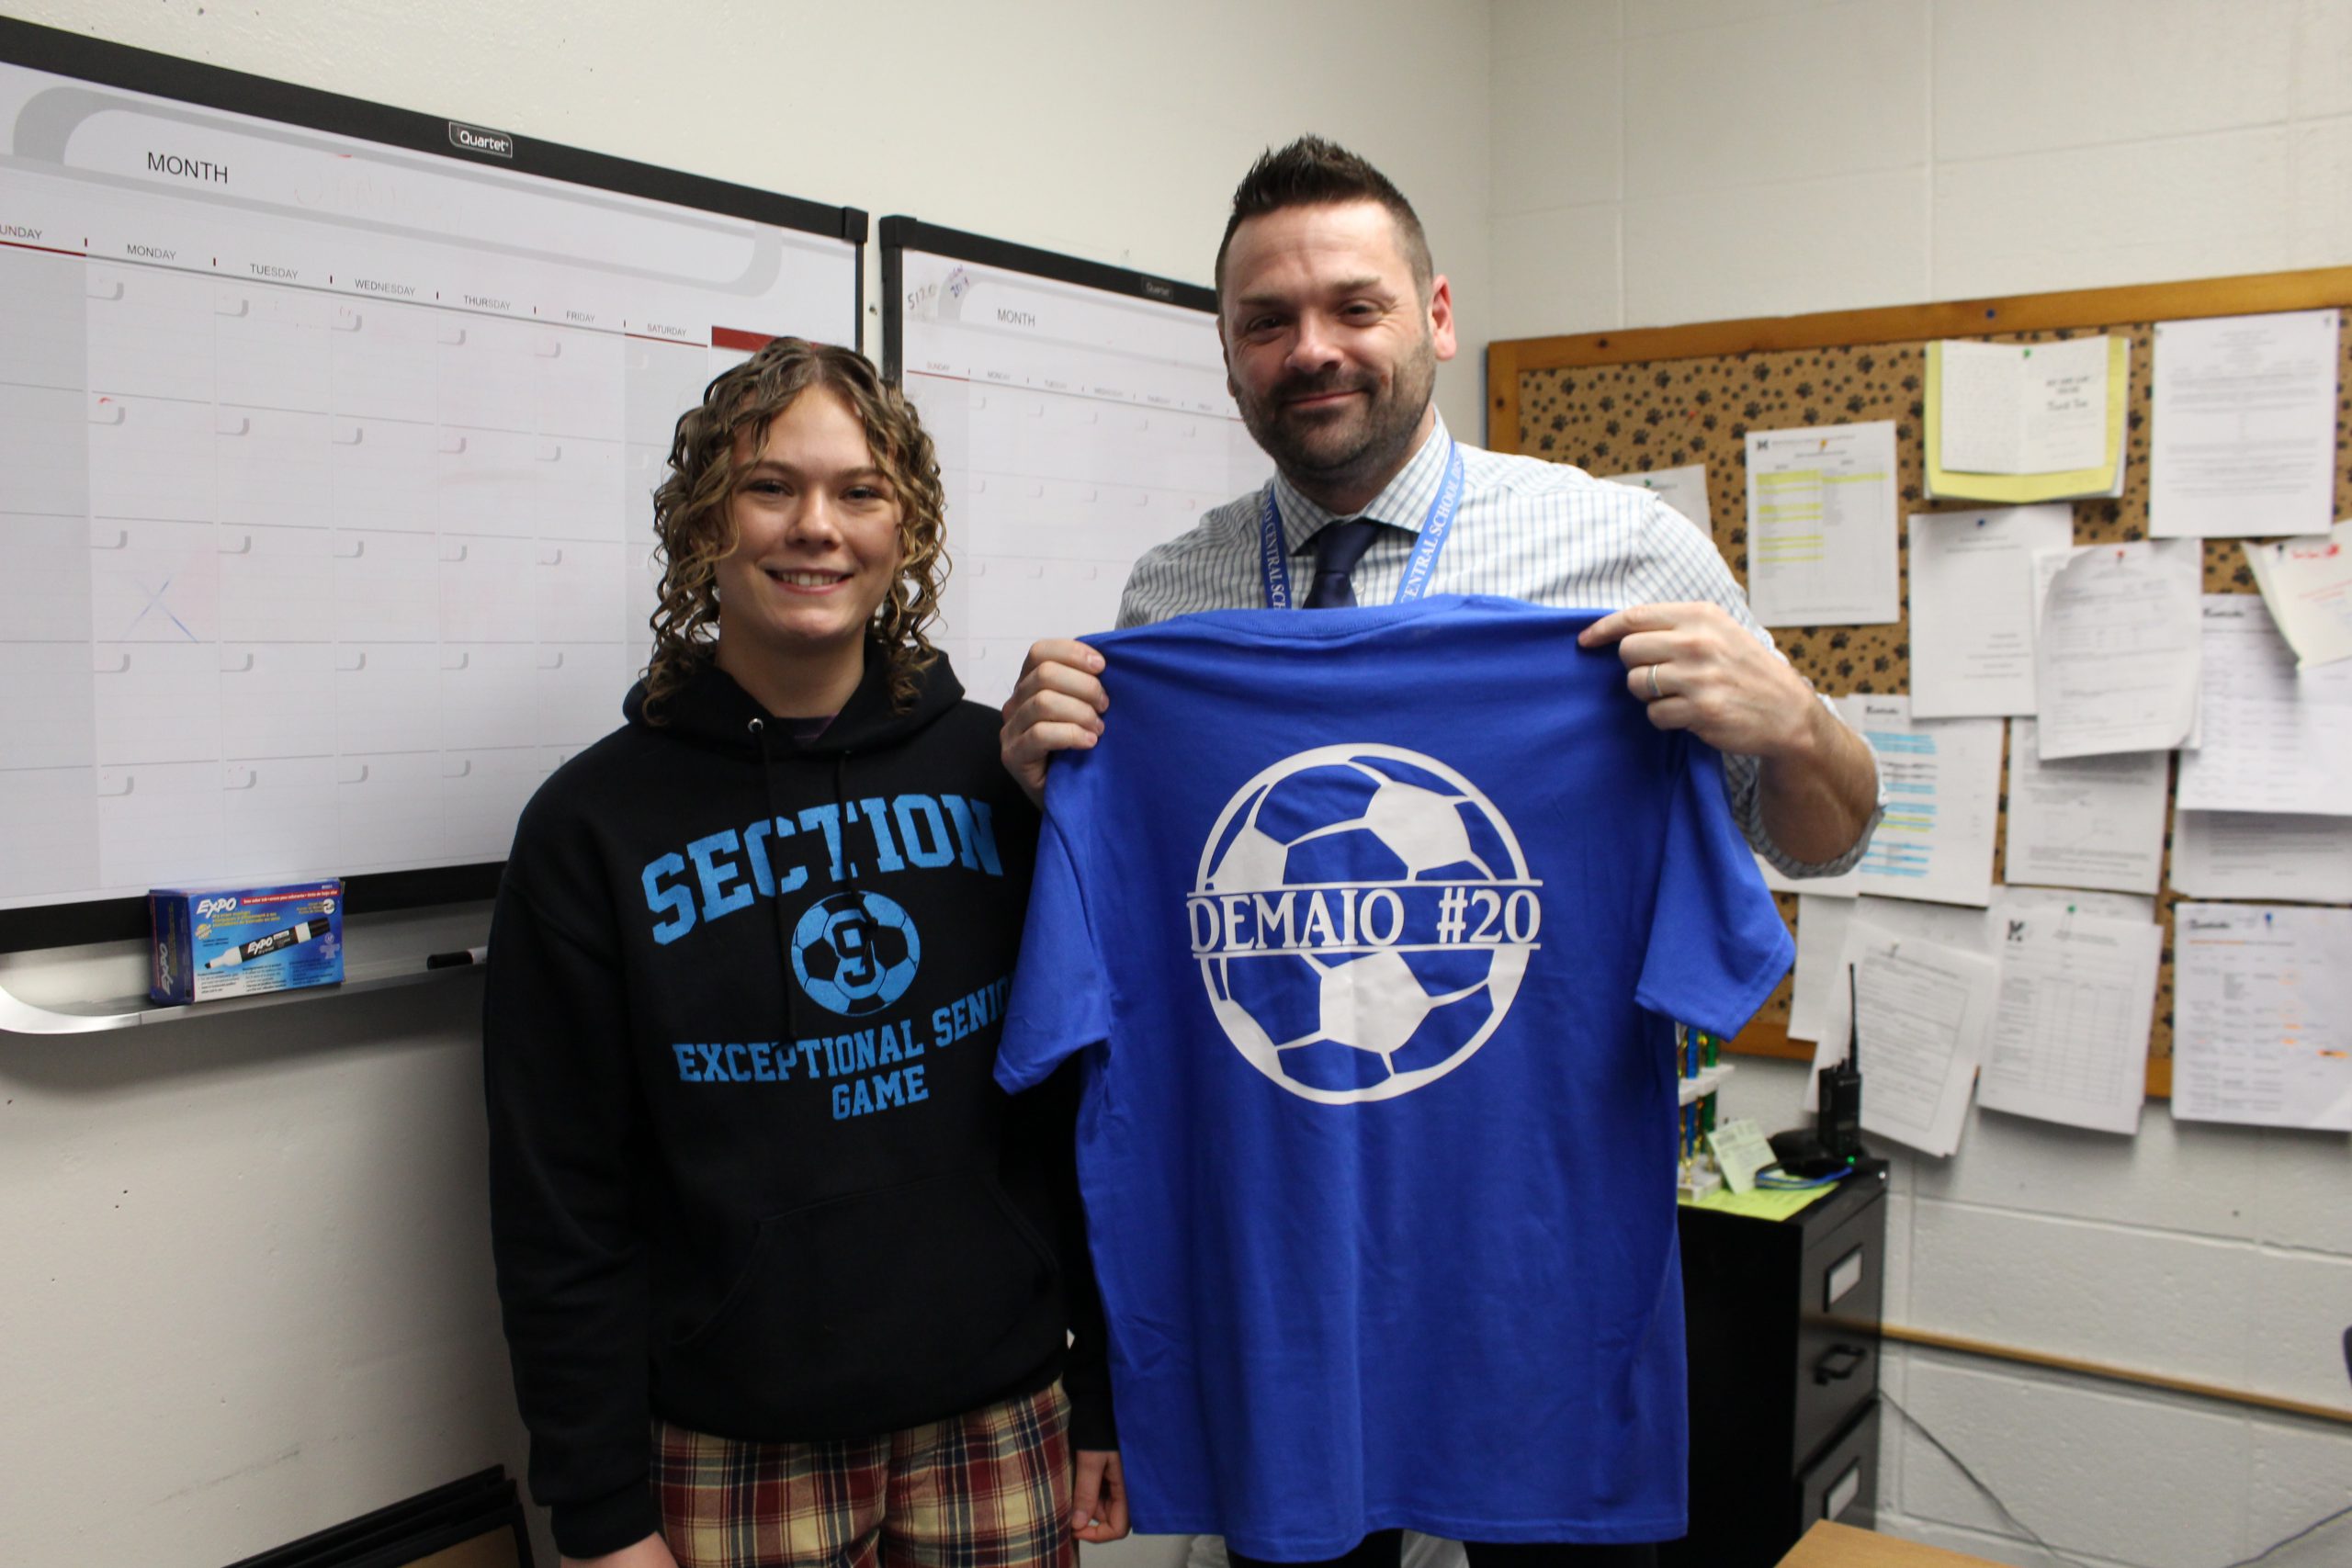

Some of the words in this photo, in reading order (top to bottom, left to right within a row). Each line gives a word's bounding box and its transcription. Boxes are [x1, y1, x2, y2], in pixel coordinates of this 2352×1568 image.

[148, 152, 229, 184] MONTH
[460, 130, 506, 152] Quartet
[0, 223, 42, 241] UNDAY
[127, 243, 176, 261] MONDAY
[249, 263, 299, 280] TUESDAY
[355, 278, 416, 297] WEDNESDAY
[464, 294, 512, 311] THURSDAY
[566, 310, 595, 323] FRIDAY
[647, 323, 687, 337] SATURDAY
[997, 308, 1035, 327] MONTH
[1430, 479, 1459, 536] SCHOOL
[1265, 522, 1283, 583] CENTRAL
[641, 794, 1003, 945] SECTION
[197, 897, 237, 919] EXPO
[1186, 888, 1405, 953] DEMAIO
[1436, 887, 1542, 944] #20
[159, 942, 174, 996] EXPO
[247, 936, 274, 955] EXPO
[831, 917, 876, 989] 9
[672, 1020, 925, 1082] EXCEPTIONAL
[932, 976, 1011, 1047] SENIO
[831, 1065, 929, 1121] GAME
